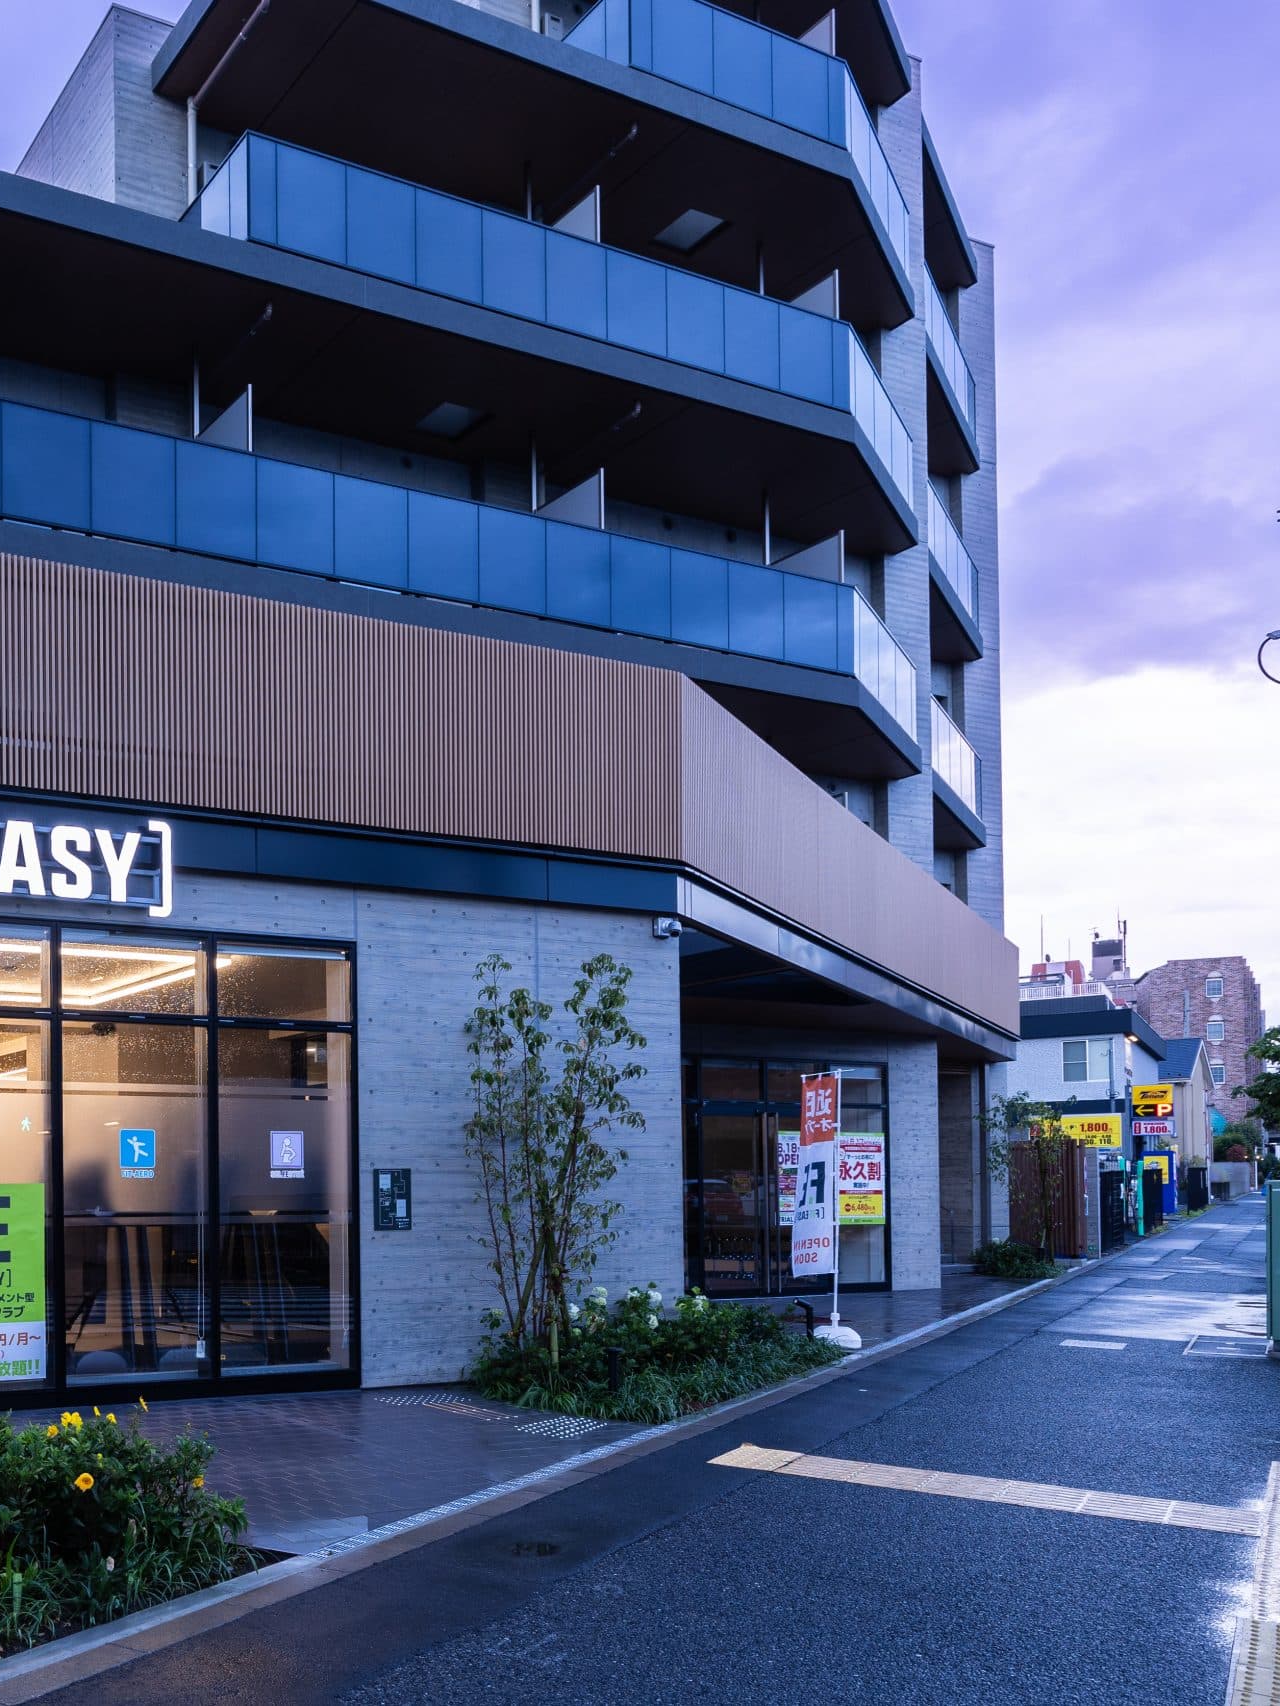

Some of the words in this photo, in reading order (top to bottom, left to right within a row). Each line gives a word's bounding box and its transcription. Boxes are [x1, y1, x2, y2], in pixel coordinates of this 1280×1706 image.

[1157, 1103, 1173, 1117] P
[839, 1161, 881, 1181] 永久割
